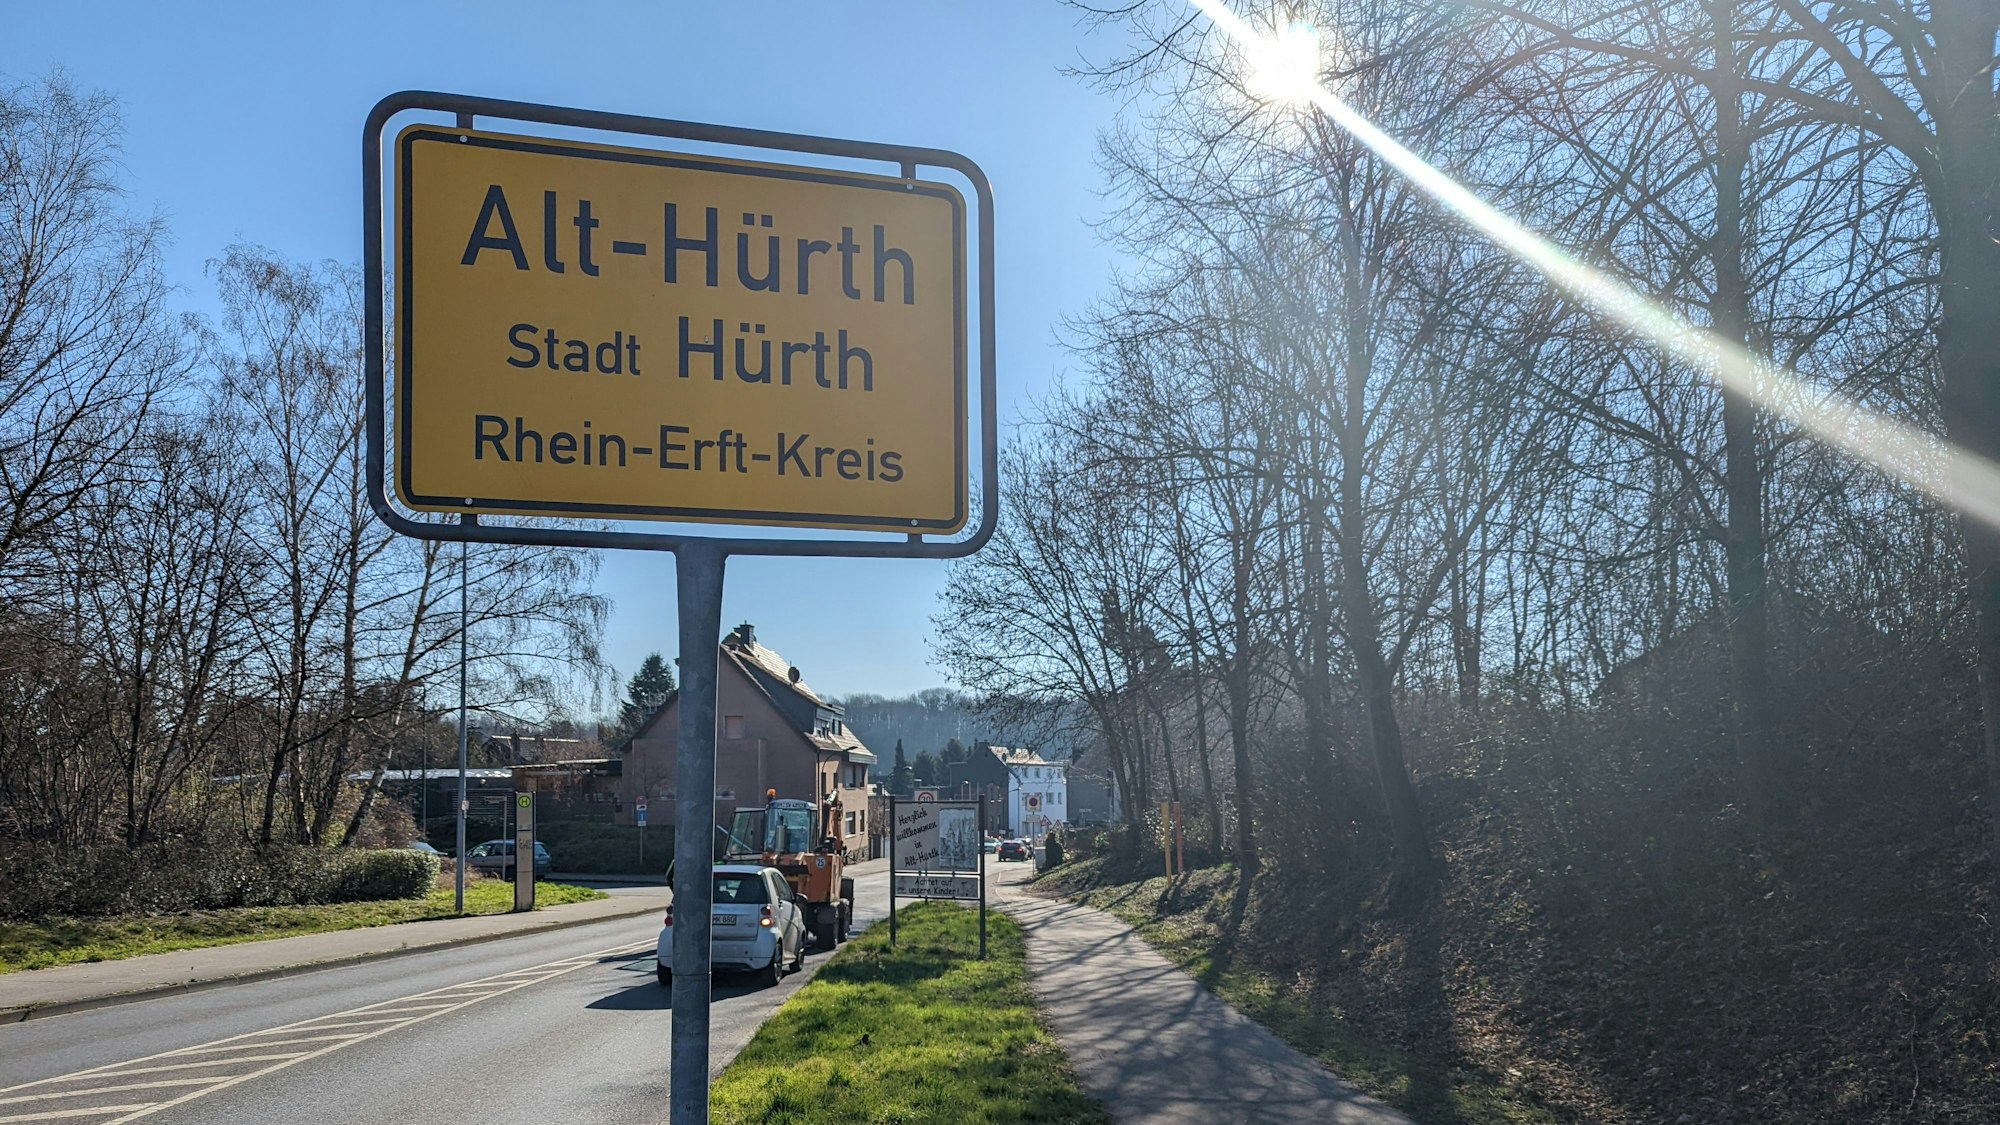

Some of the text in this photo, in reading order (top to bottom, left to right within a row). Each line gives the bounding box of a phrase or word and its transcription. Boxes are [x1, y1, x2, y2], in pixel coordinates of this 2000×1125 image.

[461, 184, 915, 304] Alt-Hürth
[506, 316, 873, 392] Stadt Hürth
[475, 414, 904, 482] Rhein-Erft-Kreis
[898, 807, 928, 826] Herzlich
[896, 821, 938, 841] willkommen
[914, 840, 923, 849] in
[908, 887, 931, 895] unsere
[915, 878, 953, 887] Achtet auf
